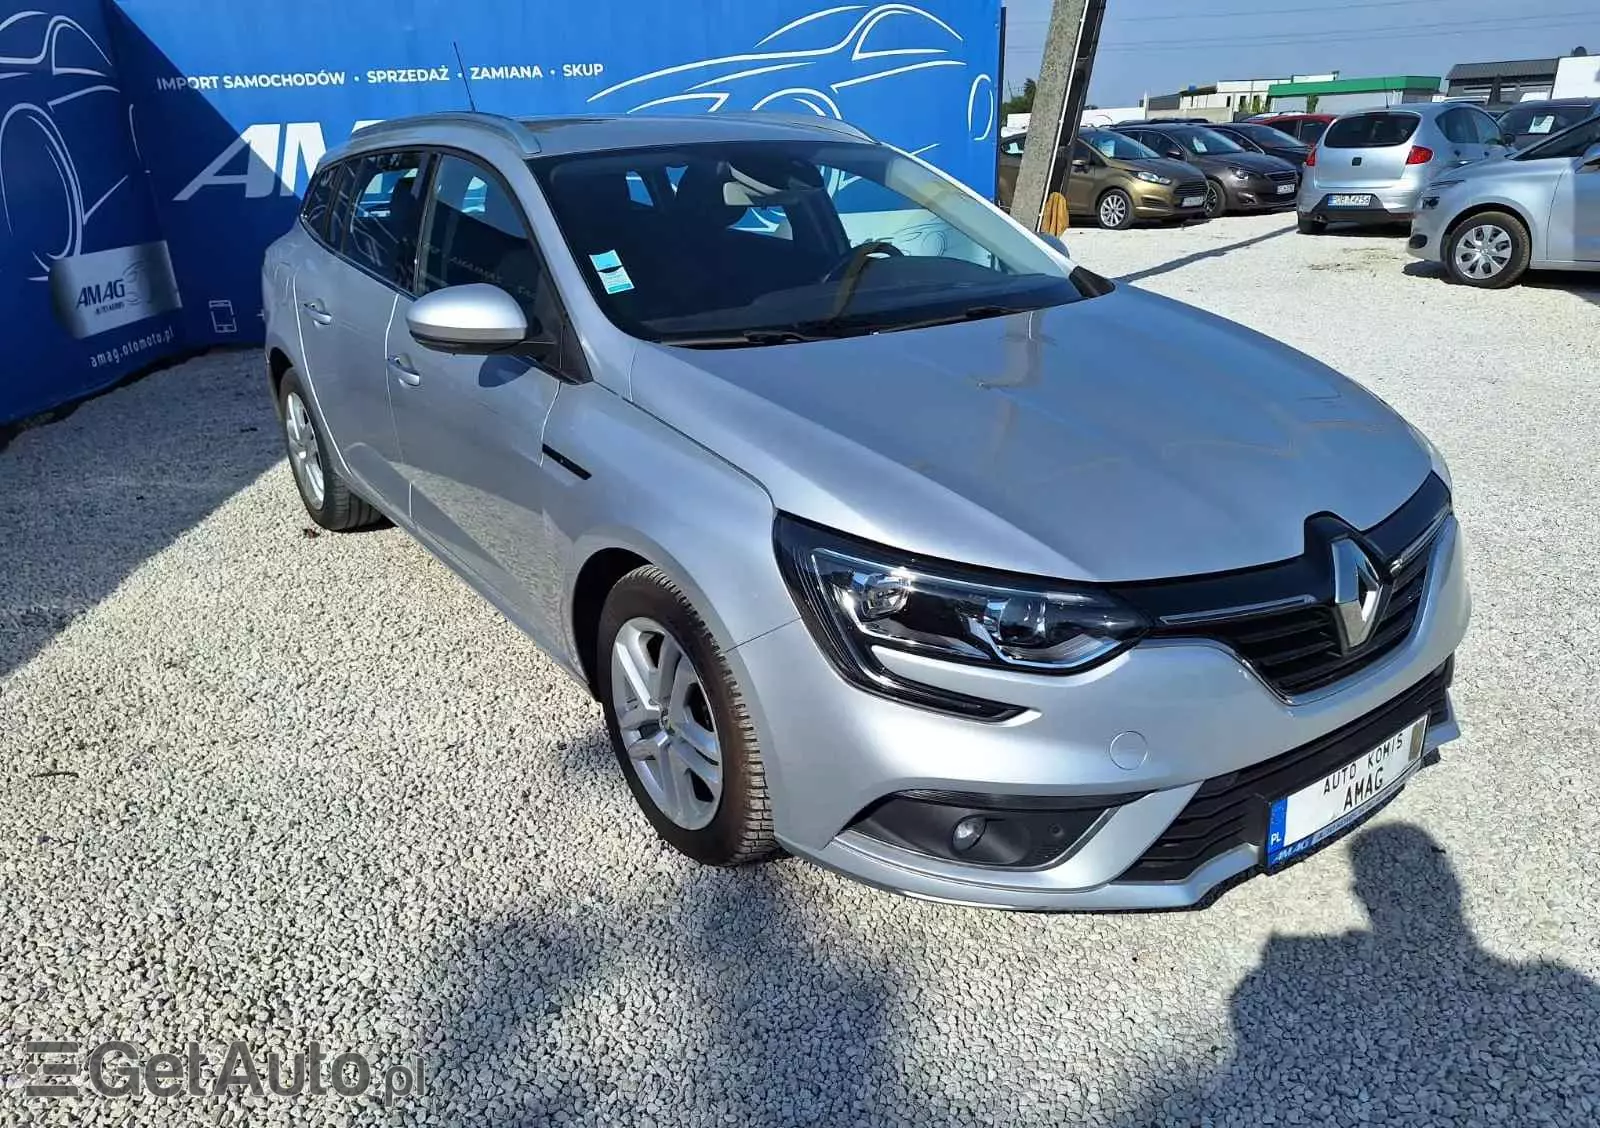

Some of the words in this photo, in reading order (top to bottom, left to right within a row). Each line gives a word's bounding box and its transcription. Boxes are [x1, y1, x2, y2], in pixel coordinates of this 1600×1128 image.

[156, 75, 218, 91] IMPORT
[223, 69, 346, 89] SAMOCHODÓW
[366, 65, 450, 84] SPRZEDAŻ
[470, 65, 543, 80] ZAMIANA
[562, 63, 604, 77] SKUP
[172, 119, 387, 201] AM
[76, 279, 125, 309] AMAG
[89, 325, 175, 368] amag.otomoto.pl
[1323, 763, 1357, 795] AUTO
[1367, 733, 1403, 769] KOMIS
[1343, 767, 1384, 811] AMAG
[1271, 832, 1281, 846] PL
